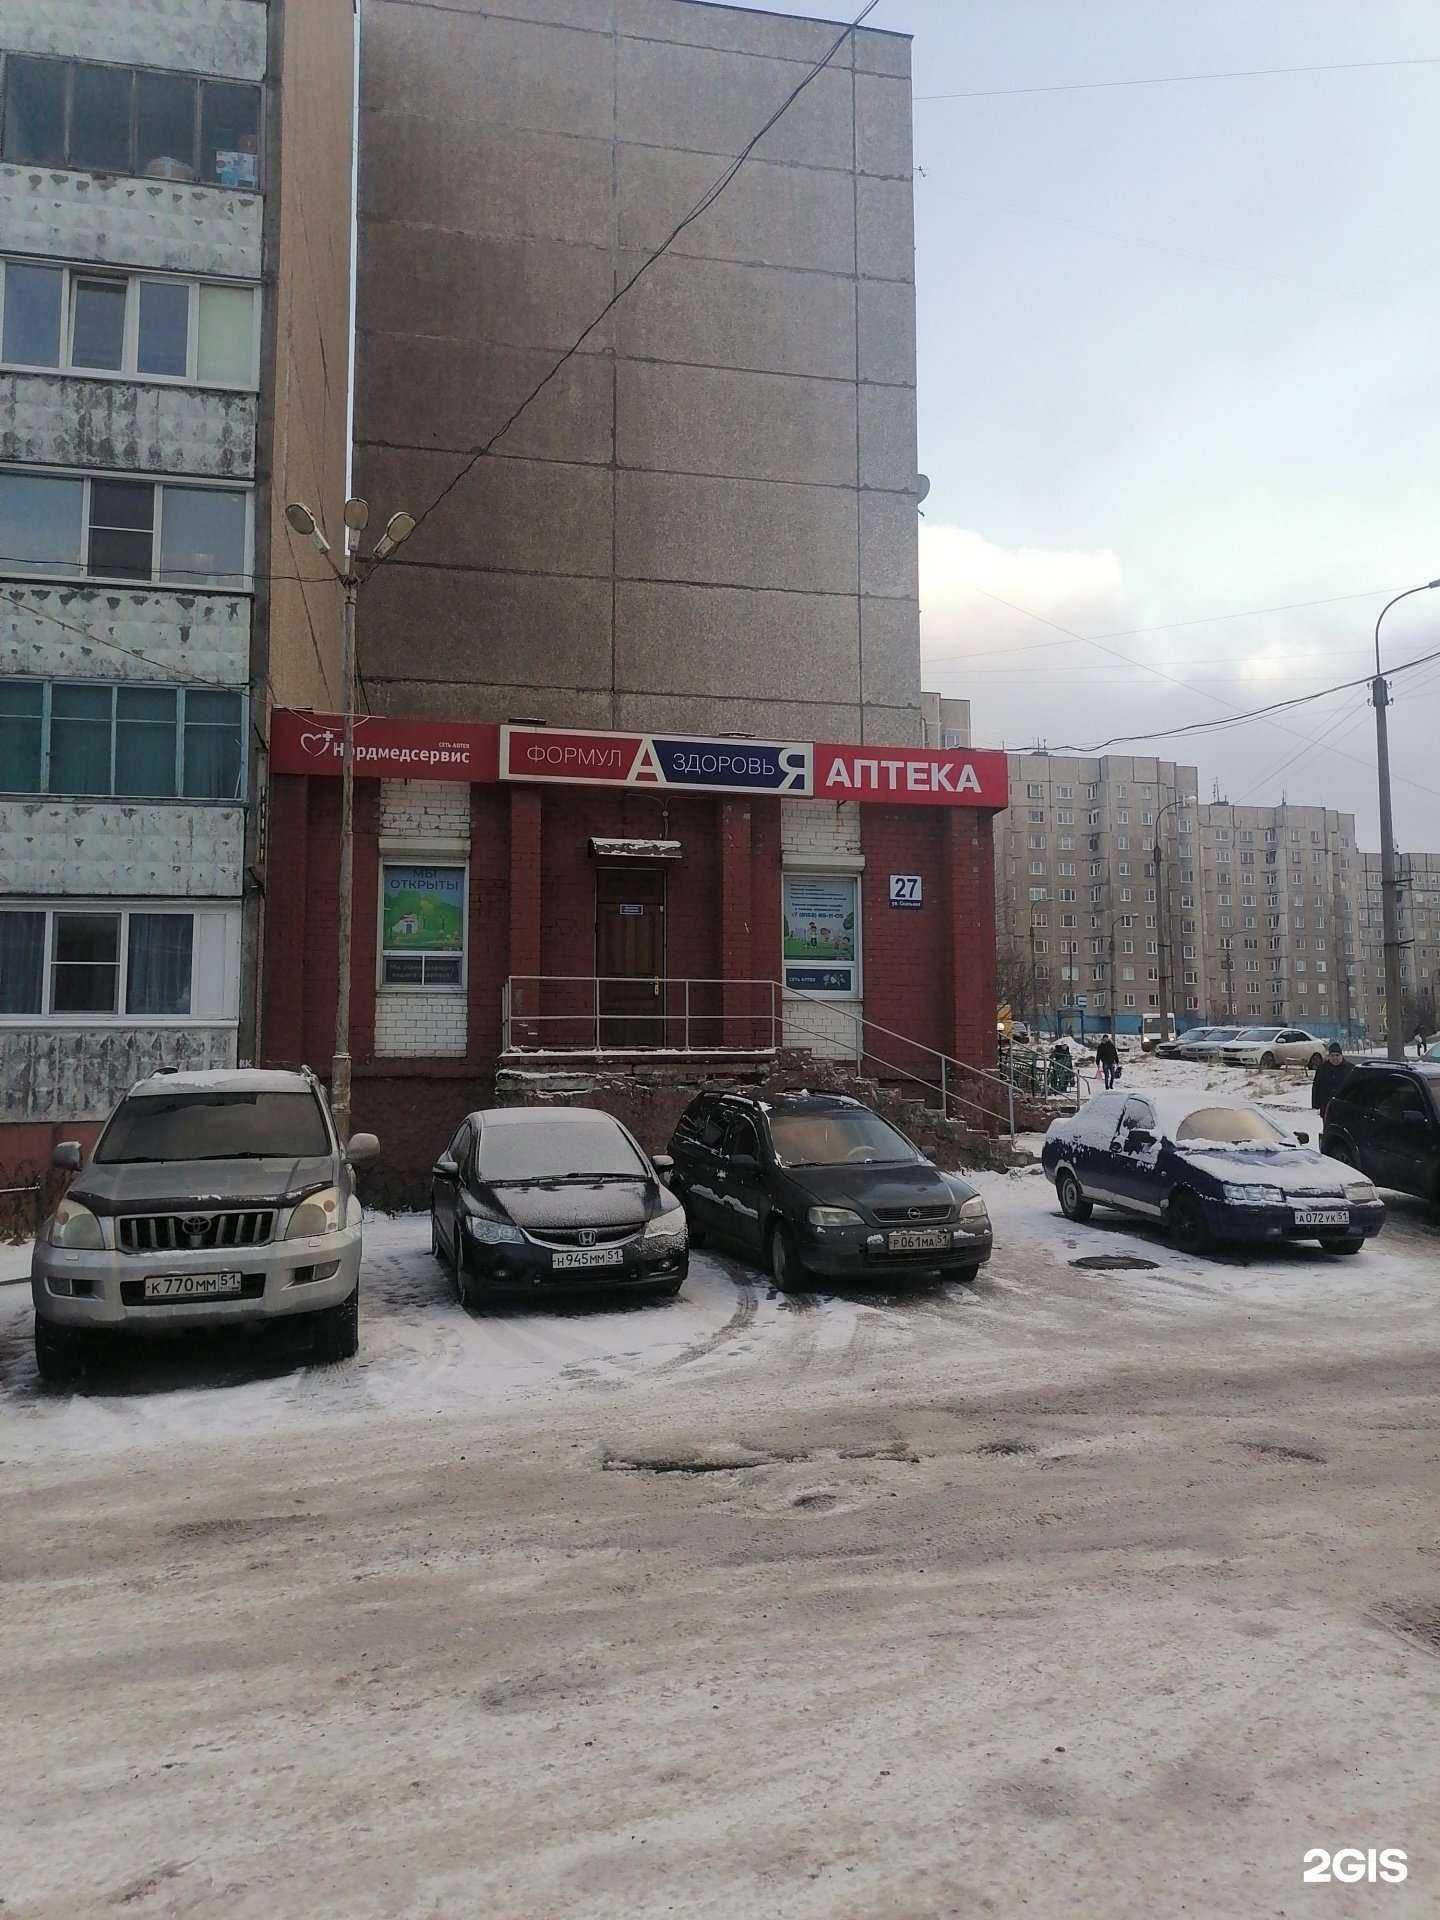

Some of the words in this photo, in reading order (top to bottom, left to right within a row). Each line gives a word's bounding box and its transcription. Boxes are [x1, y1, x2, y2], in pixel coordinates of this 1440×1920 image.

[333, 741, 470, 765] Нрдмедсервис
[825, 757, 982, 793] АПТЕКА
[413, 868, 437, 878] МЫ
[391, 879, 459, 890] ОТКРЫТЫ
[895, 878, 918, 898] 27
[937, 1235, 947, 1243] 51
[557, 1253, 605, 1266] Н945ММ
[607, 1251, 619, 1259] 51
[151, 1277, 217, 1294] К770ММ
[220, 1274, 236, 1285] 51
